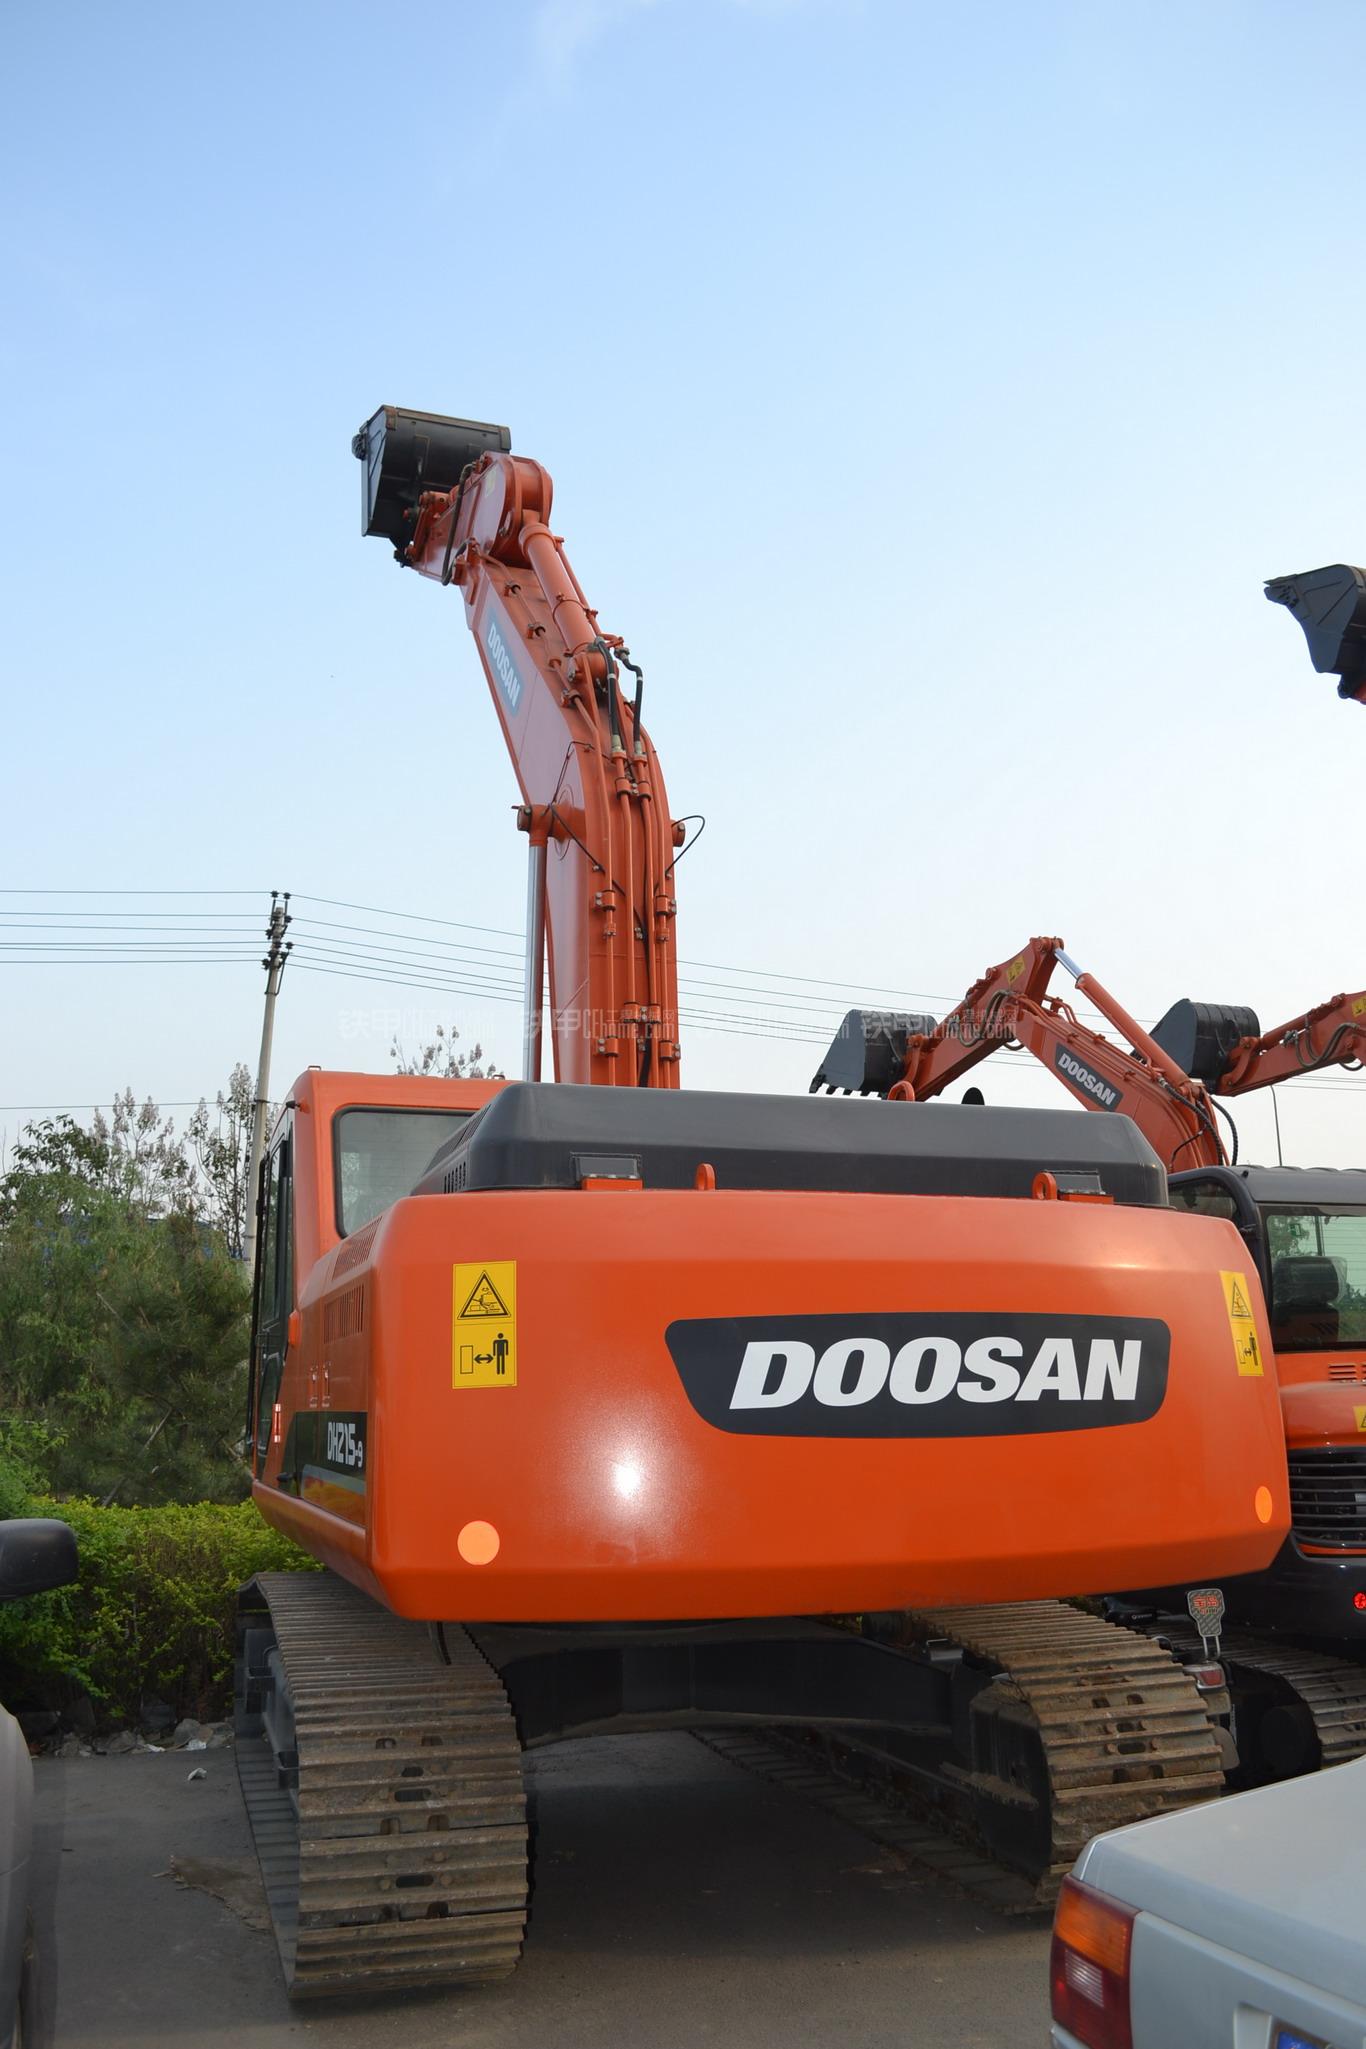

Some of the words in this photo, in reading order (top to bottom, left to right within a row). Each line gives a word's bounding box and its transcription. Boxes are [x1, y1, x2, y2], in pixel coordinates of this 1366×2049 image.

[487, 622, 521, 707] DOOSAN
[1057, 1052, 1116, 1106] DOOSAN
[729, 1336, 1142, 1410] DOOSAN
[327, 1421, 364, 1468] DH215-9
